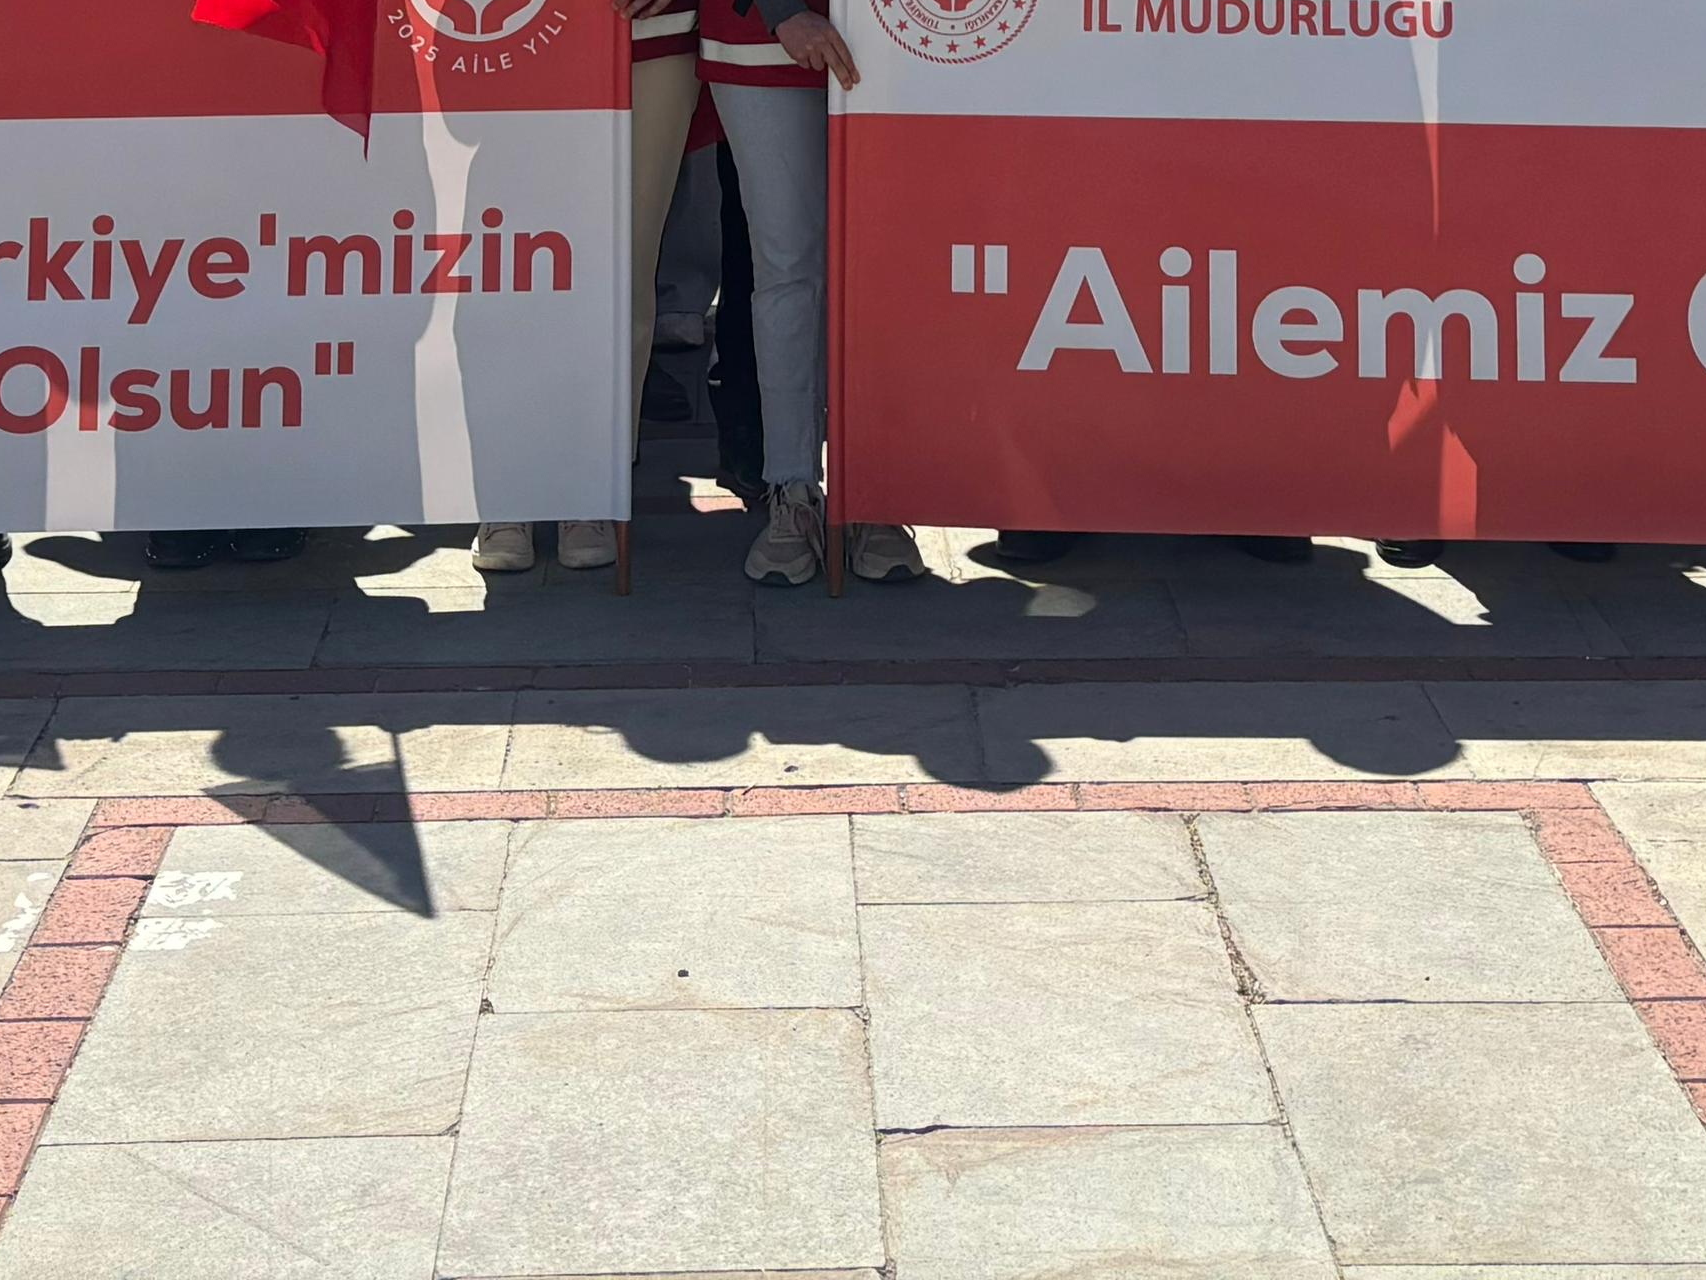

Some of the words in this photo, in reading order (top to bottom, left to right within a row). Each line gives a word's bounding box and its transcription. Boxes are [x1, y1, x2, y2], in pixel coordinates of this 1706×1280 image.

[387, 8, 439, 63] 2025
[451, 52, 514, 75] AİLE
[523, 10, 569, 57] YILI
[949, 242, 1639, 385] "Ailemiz
